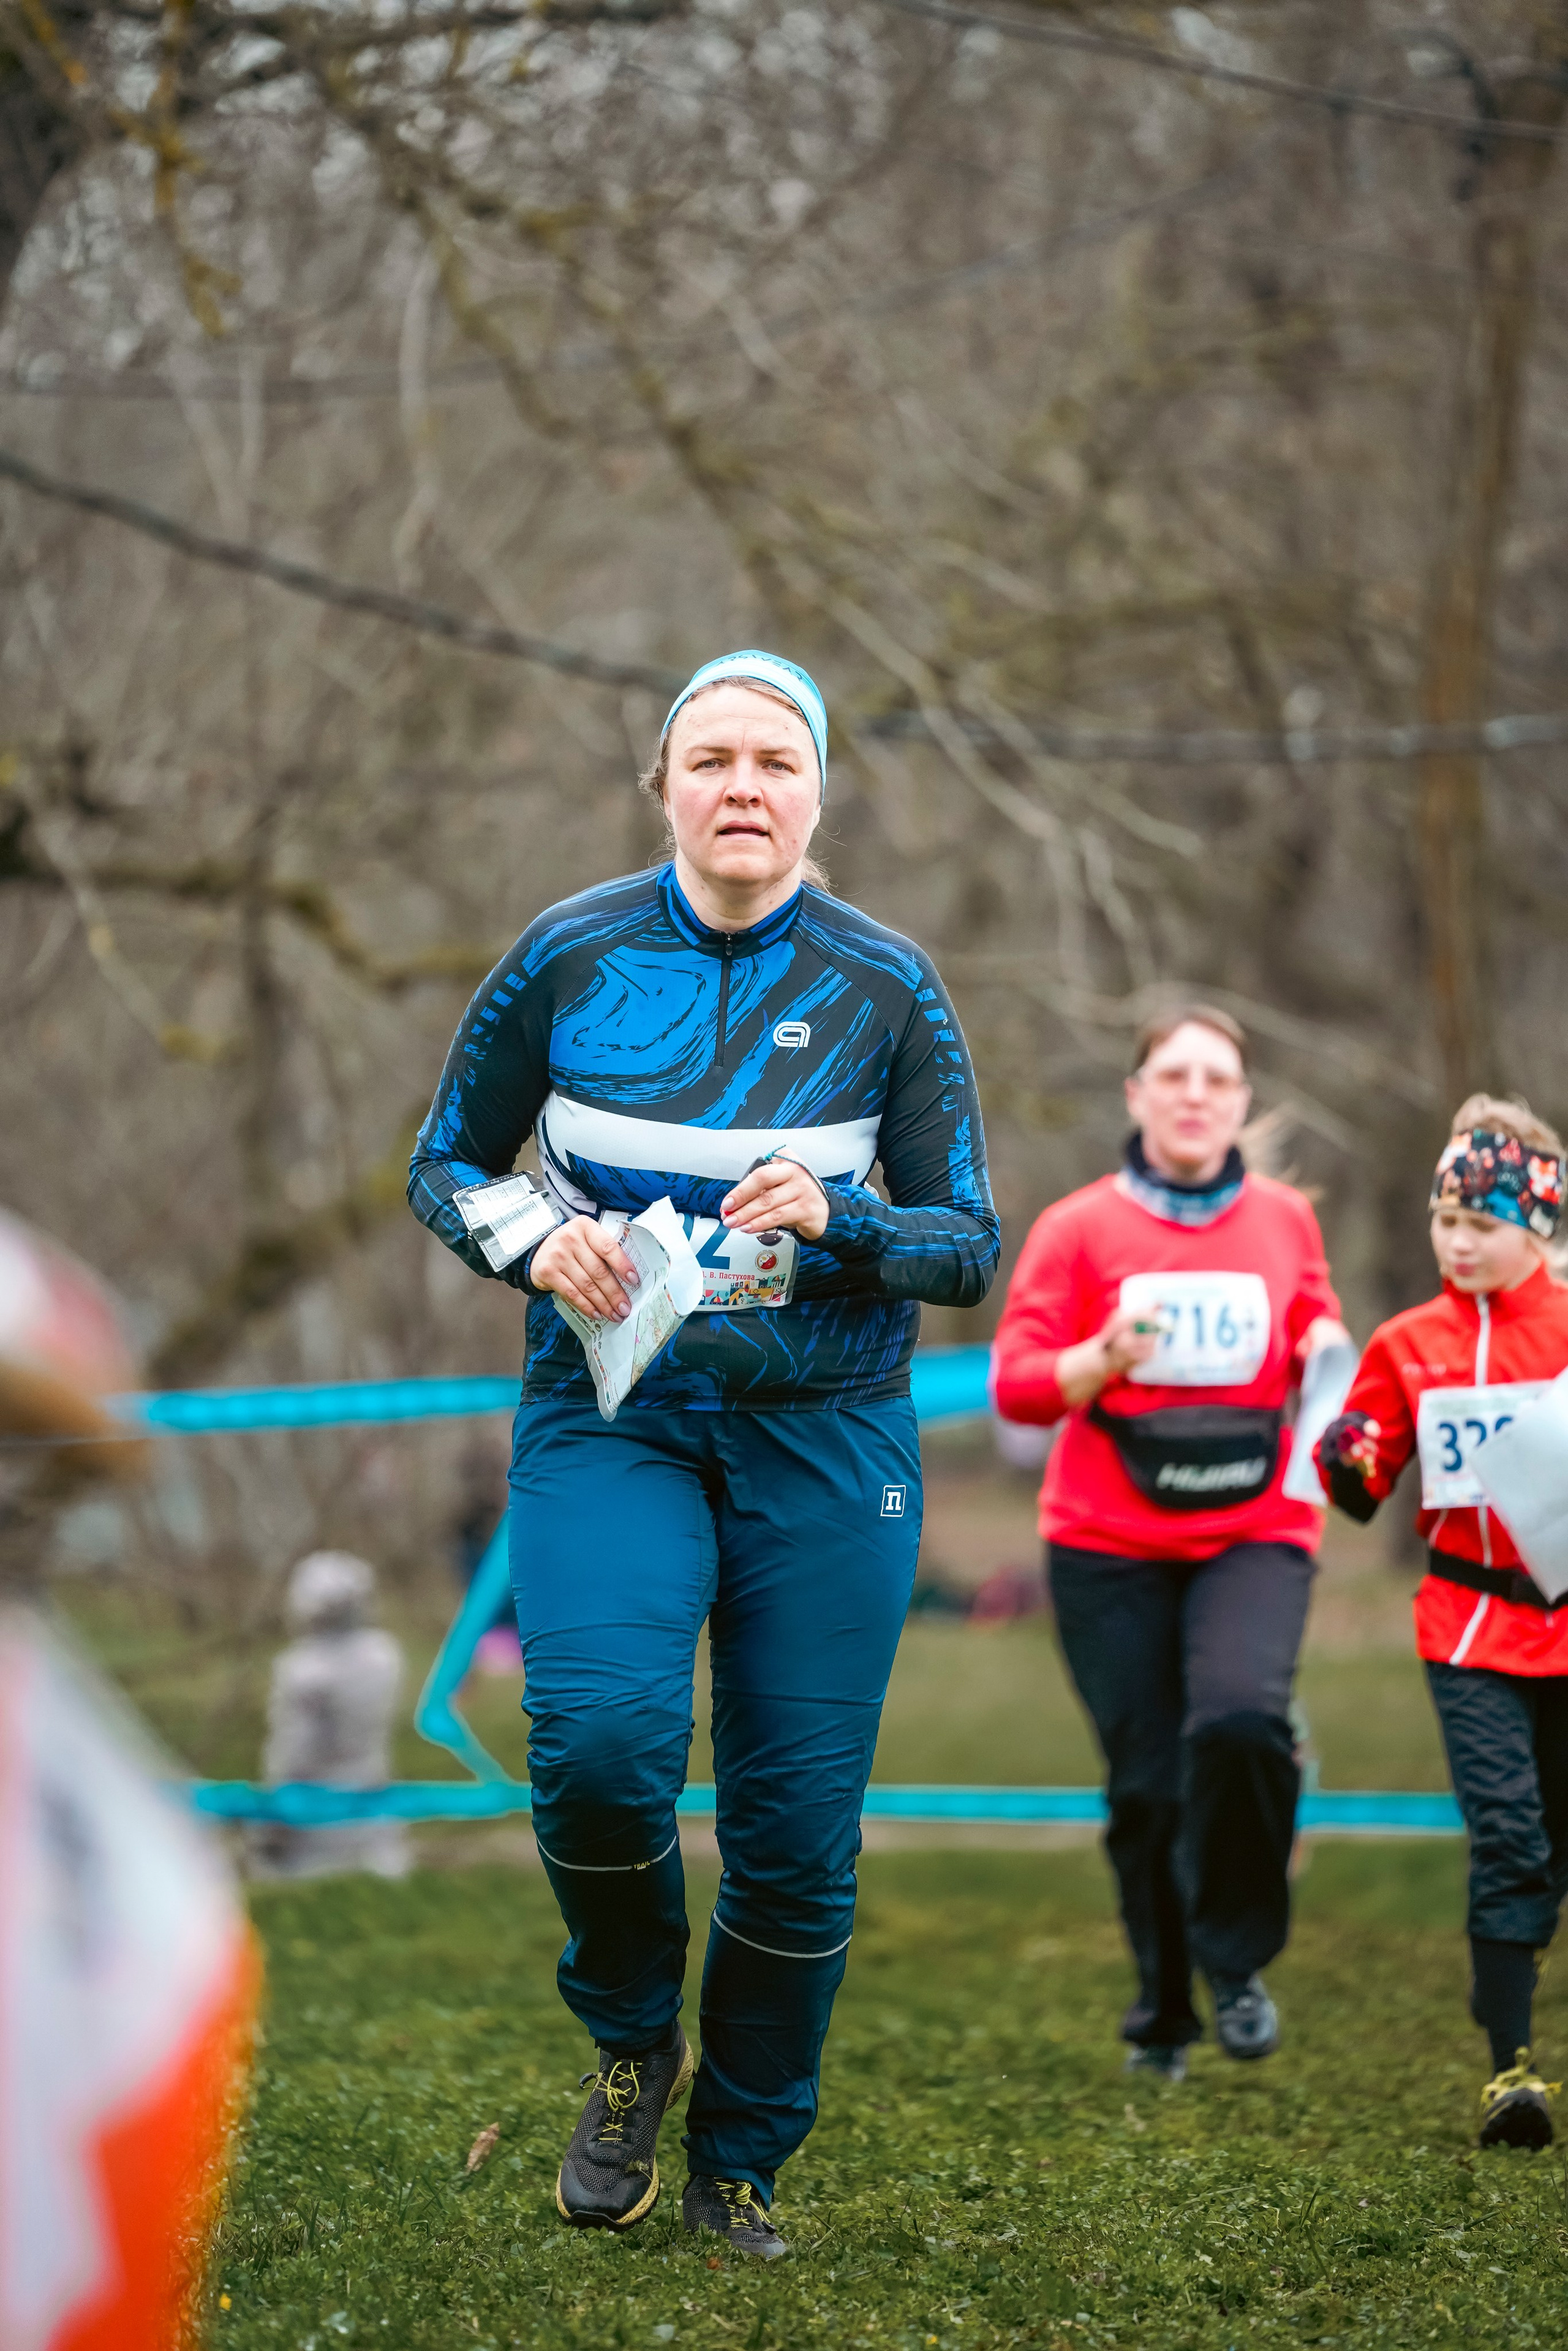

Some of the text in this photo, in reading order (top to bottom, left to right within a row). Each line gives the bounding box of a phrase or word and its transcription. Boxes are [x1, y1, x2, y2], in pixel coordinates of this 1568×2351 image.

[719, 1272, 755, 1281] Пастухова
[1438, 1415, 1513, 1473] 32
[633, 1861, 650, 1870] TRAIL
